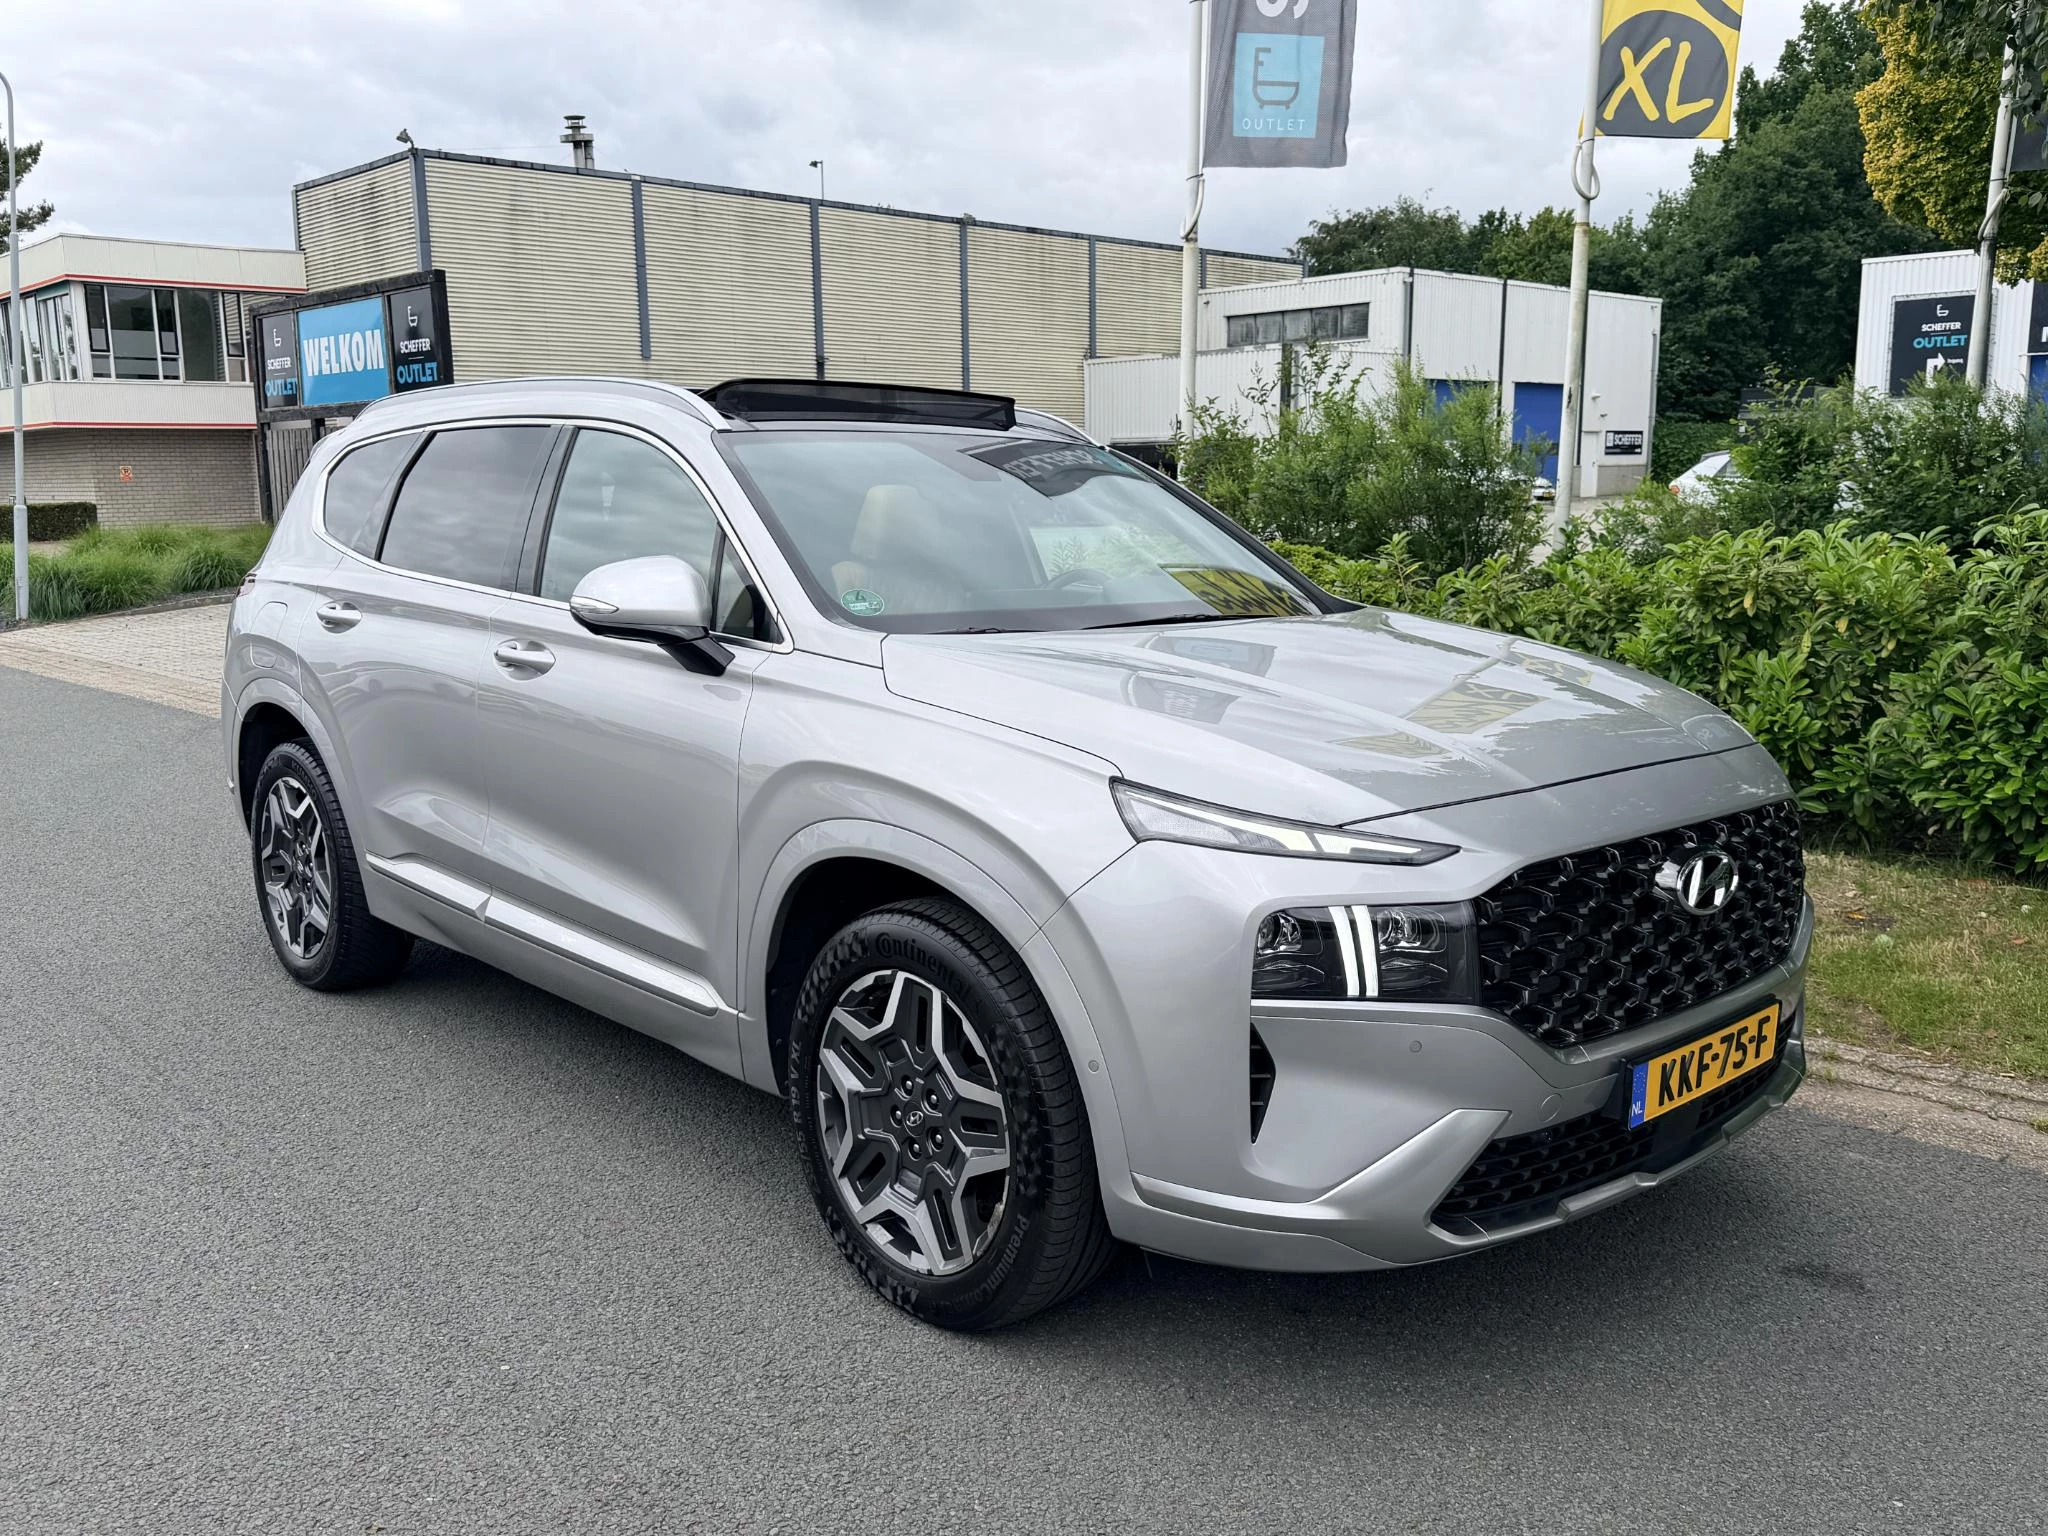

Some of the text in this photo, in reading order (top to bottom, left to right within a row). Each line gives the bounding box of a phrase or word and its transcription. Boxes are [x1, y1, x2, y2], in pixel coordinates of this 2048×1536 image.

[1602, 36, 1715, 124] XL
[1241, 118, 1306, 131] OUTLET
[1921, 322, 1961, 332] SCHEFFER
[400, 338, 431, 353] SCHEFFER
[1912, 334, 1968, 349] OUTLET
[303, 329, 385, 377] WELKOM
[267, 357, 292, 370] SCHEFFER
[396, 361, 438, 385] OUTLET
[265, 378, 298, 397] OUTLET
[1614, 434, 1642, 445] SCHEFFER
[876, 932, 971, 999] Continental
[1658, 1015, 1771, 1107] KKF-75-F
[1631, 1101, 1643, 1116] NL
